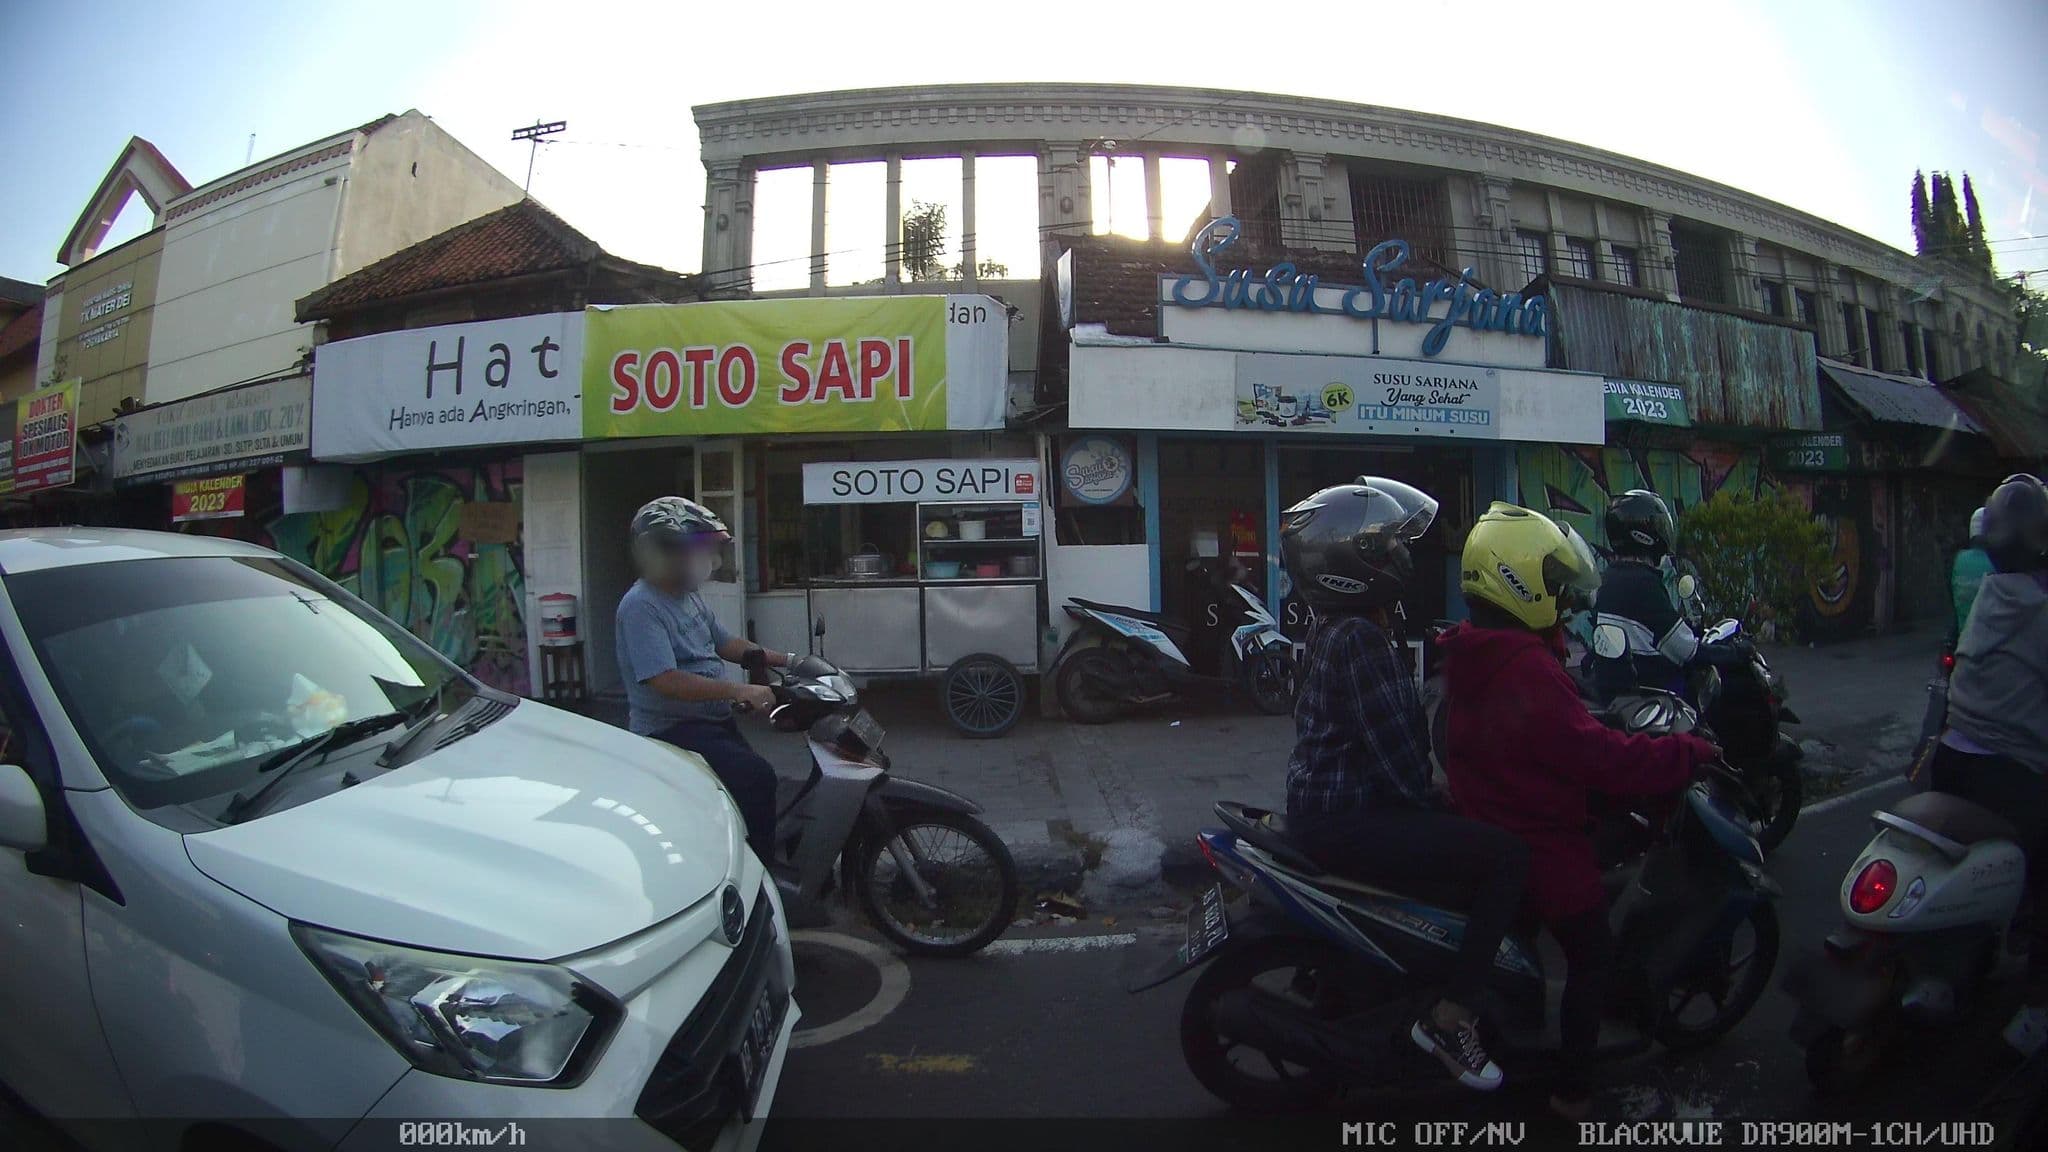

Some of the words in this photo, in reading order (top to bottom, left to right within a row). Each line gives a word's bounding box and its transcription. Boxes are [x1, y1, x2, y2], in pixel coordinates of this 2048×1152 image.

[1172, 214, 1318, 312] Susu
[1341, 239, 1549, 356] Sarjana
[426, 336, 559, 399] Hat
[611, 344, 757, 413] SOTO
[781, 337, 914, 405] SAPI
[1373, 373, 1411, 385] SUSU
[1415, 376, 1478, 390] SARJANA
[1629, 383, 1682, 400] KALENDER
[1327, 391, 1349, 407] 6K
[1380, 387, 1426, 407] Yang
[1428, 390, 1471, 405] Sehat
[389, 406, 434, 431] Hanya
[439, 406, 465, 423] ada
[469, 399, 571, 423] Angkringan,
[1359, 406, 1388, 419] ITU
[1392, 407, 1446, 422] MINUM
[1449, 410, 1488, 424] SUSU
[1623, 398, 1668, 419] 2023
[23, 412, 69, 440] SPESIALIS
[1787, 450, 1825, 466] 2023
[199, 475, 243, 492] KALENDER
[832, 469, 924, 496] SOTO
[936, 468, 1010, 494] SAPI
[190, 493, 226, 513] 2023
[1320, 576, 1362, 589] INK
[1502, 567, 1529, 596] INK
